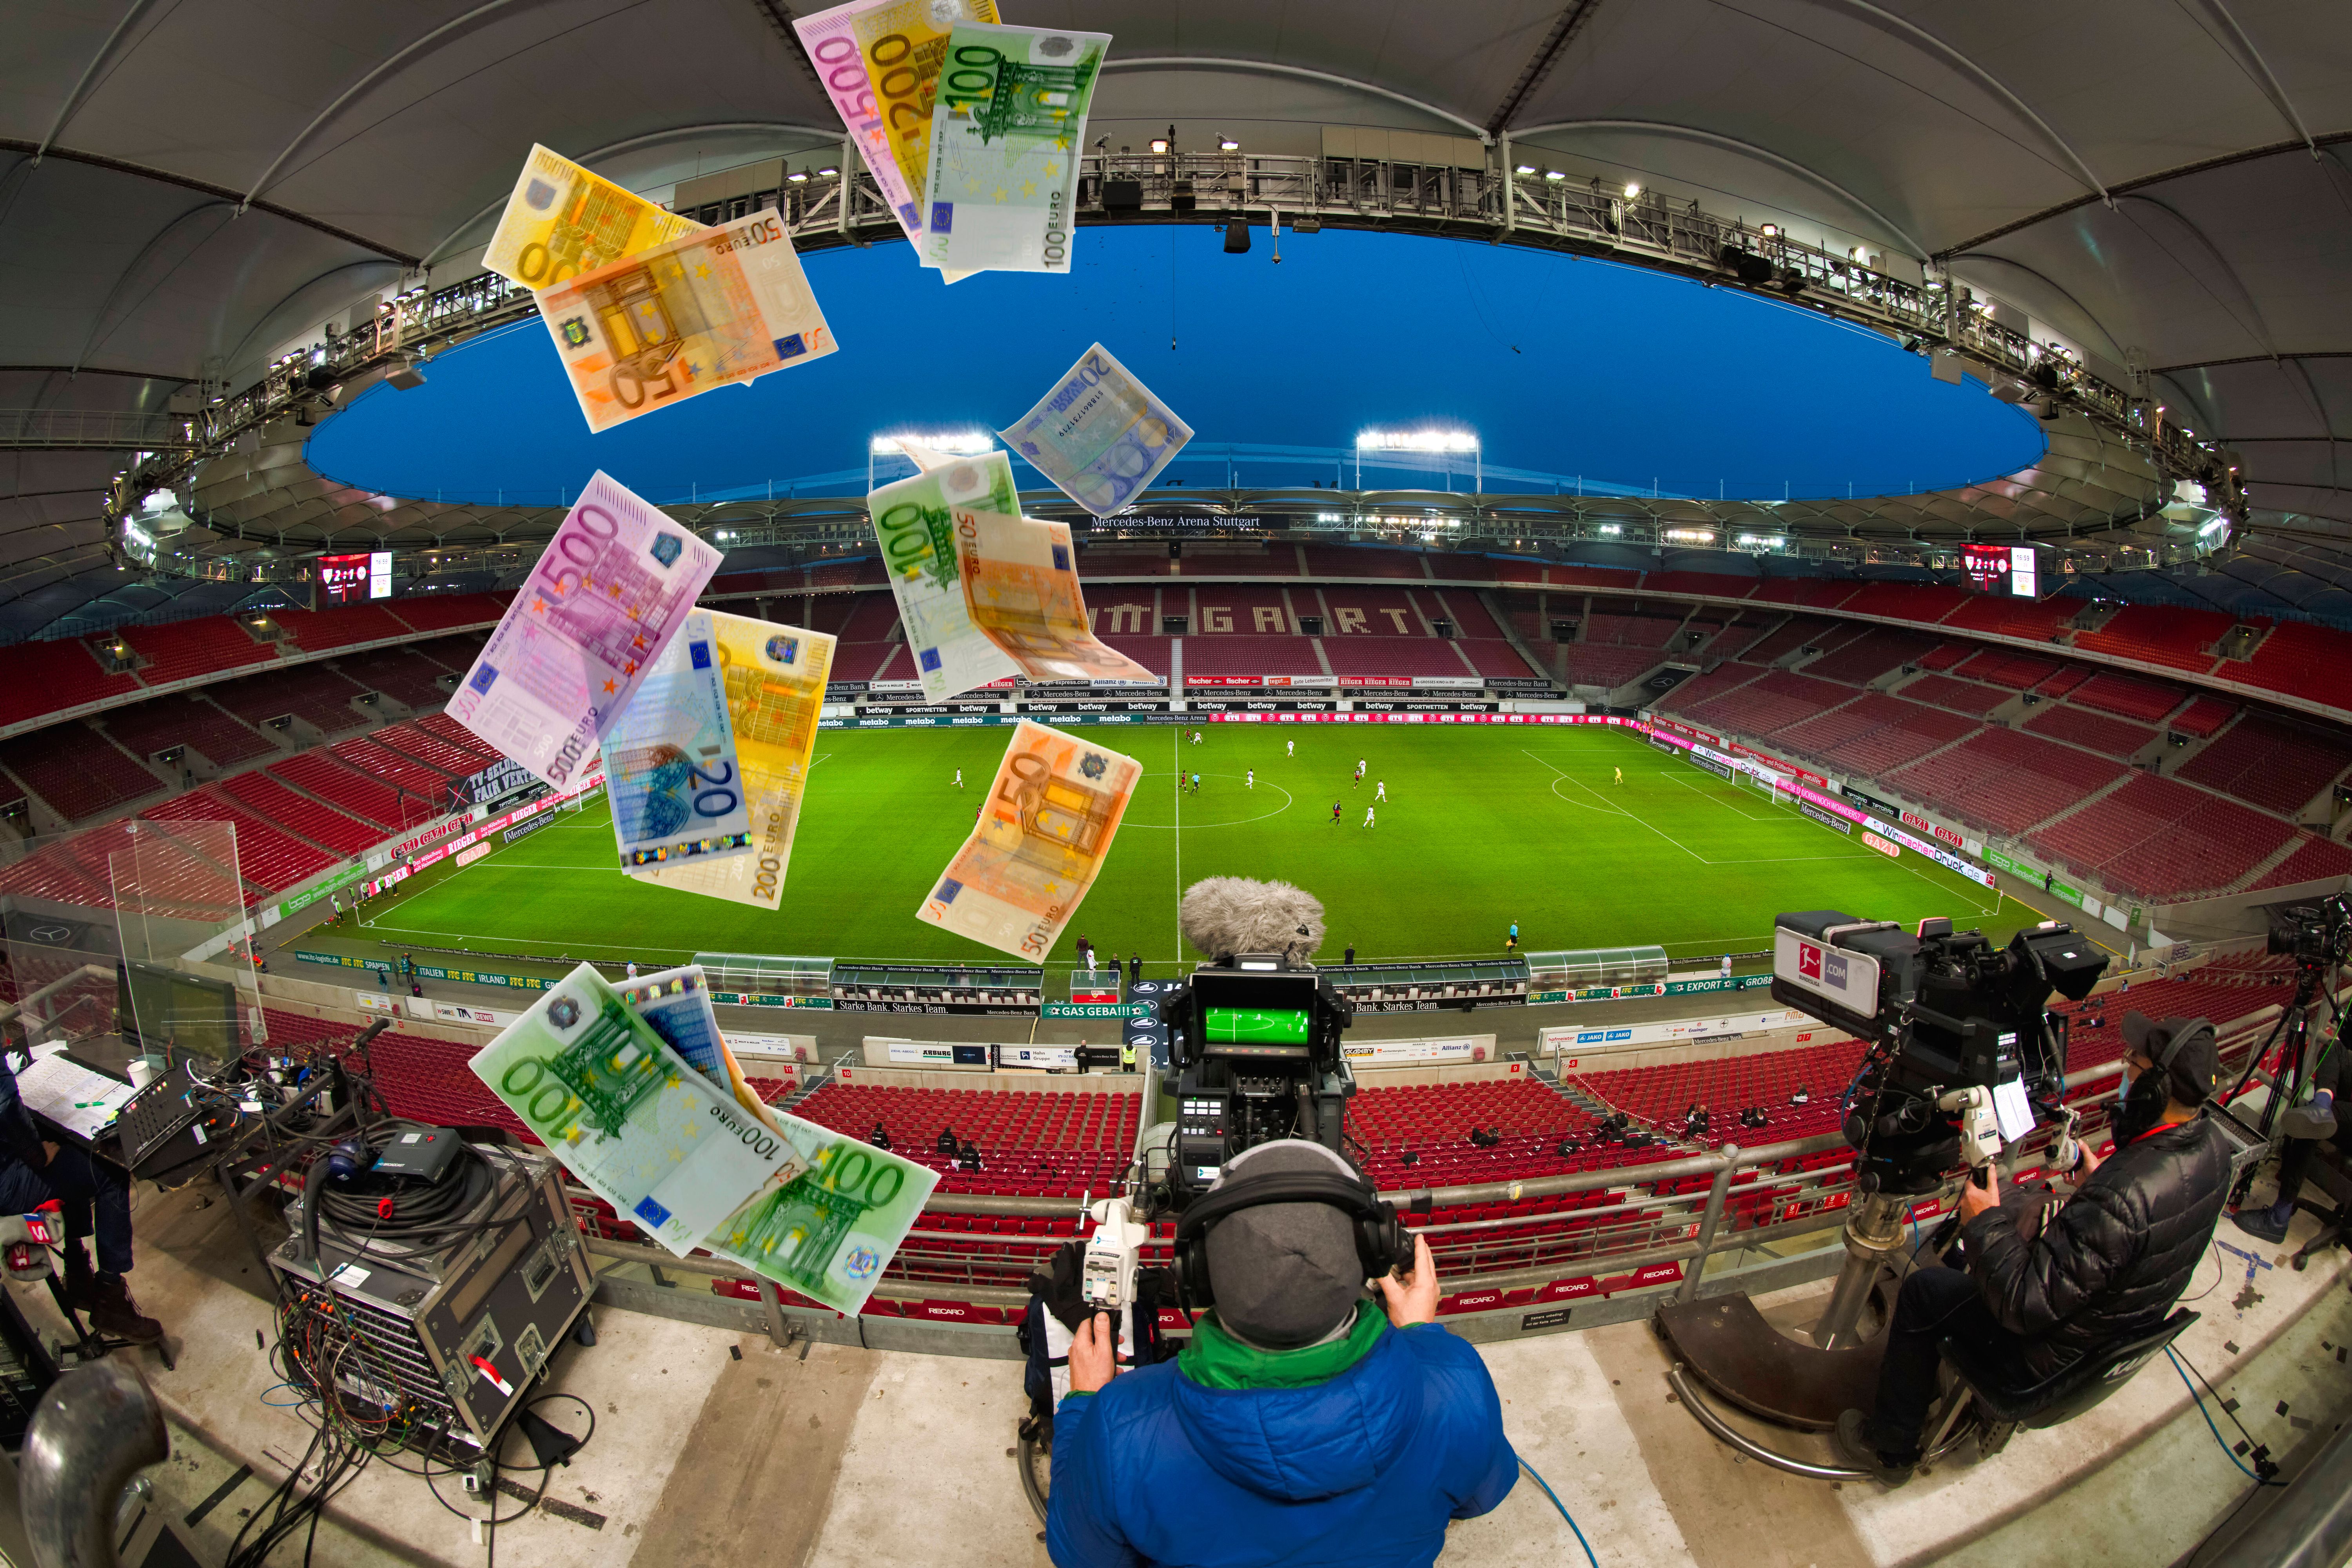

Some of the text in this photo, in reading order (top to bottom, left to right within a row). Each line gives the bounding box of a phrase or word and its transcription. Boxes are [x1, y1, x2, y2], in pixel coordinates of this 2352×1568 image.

[869, 34, 932, 132] 200
[944, 45, 1002, 109] 100
[715, 216, 782, 256] 50 EURO
[1044, 192, 1066, 269] 100 EURO
[609, 349, 677, 410] 50
[1079, 356, 1111, 387] 20
[1059, 390, 1103, 437] S18861731719
[956, 511, 977, 538] 50
[1092, 516, 1260, 528] Mercedes-Benz Arena Stuttgart
[880, 501, 929, 575] 100
[540, 503, 619, 598] 500
[1029, 704, 1057, 712] betway
[1128, 702, 1157, 711] betway
[1298, 702, 1326, 710] betway
[1366, 702, 1393, 711] betway
[1461, 703, 1487, 711] betway
[1653, 717, 1710, 742] fischer fischer fischer
[546, 706, 599, 785] 500 EURO
[1670, 735, 1690, 748] WOANDERS?
[1690, 754, 1728, 777] Mercedes-Benz
[1704, 748, 1771, 782] WirmachenDruck.de
[1774, 760, 1822, 785] Prüftechnik. dataTec
[688, 760, 738, 818] 20
[997, 752, 1051, 807] 50
[474, 781, 503, 803] FAIR
[1796, 785, 1860, 820] DRUCKEN NOCH WOANDERS?
[488, 817, 506, 828] Möbelhaus
[512, 803, 537, 823] RIEGER
[488, 822, 507, 834] Heimvorteil
[447, 832, 477, 855] RIEGER
[1883, 824, 1980, 881] WirmachenDruck.de
[421, 849, 443, 863] Möbelhaus
[421, 854, 443, 869] Heimvorteil
[754, 812, 781, 901] 200 EURO
[313, 866, 367, 899] www.bgm-express.com
[2049, 883, 2081, 906] Europaweit
[1020, 905, 1059, 956] 50 EURO
[297, 953, 339, 964] www.itc-logistic.de
[366, 961, 390, 971] SPANIEN
[1826, 964, 1846, 980] .COM
[419, 967, 541, 988] ITALIEN ITC ITC IRLAND ITC ITC
[1687, 980, 1722, 991] EXPORT
[1798, 974, 1820, 987] BUNDESLIGA
[840, 1001, 948, 1014] Starke Bank. Starkes Team.
[1062, 1007, 1130, 1016] GAS GEBA!!!
[1356, 1000, 1439, 1012] Bank. Starkes Team.
[501, 1055, 586, 1140] 100
[710, 1105, 781, 1162] 100 EURO
[818, 1140, 905, 1209] 100
[2018, 1171, 2037, 1183] RECARO
[1914, 1204, 1937, 1217] RECARO
[1643, 1268, 1675, 1279] RECARO
[1555, 1283, 1589, 1293] RECARO
[928, 1307, 964, 1316] RECARO
[1459, 1296, 1495, 1305] RECARO
